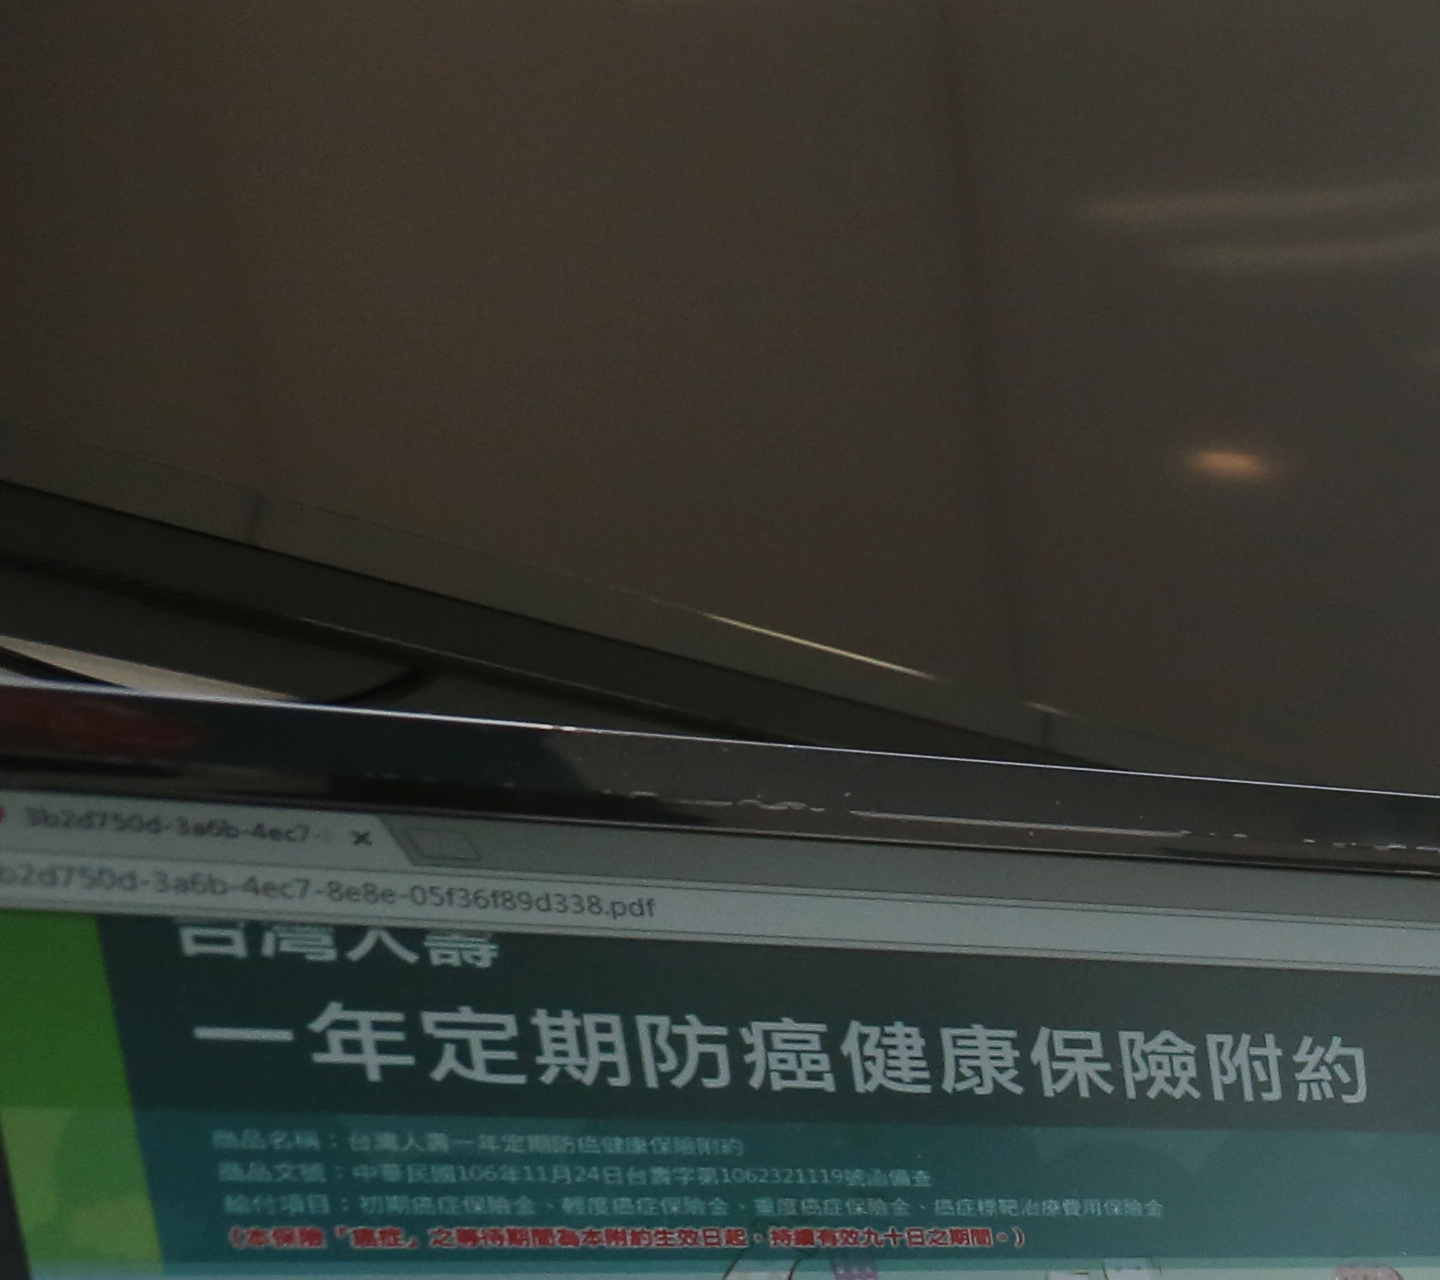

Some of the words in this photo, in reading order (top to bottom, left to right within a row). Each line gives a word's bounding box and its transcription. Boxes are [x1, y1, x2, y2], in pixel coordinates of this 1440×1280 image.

[194, 1001, 1368, 1105] 一年定期防癌健康保險附約
